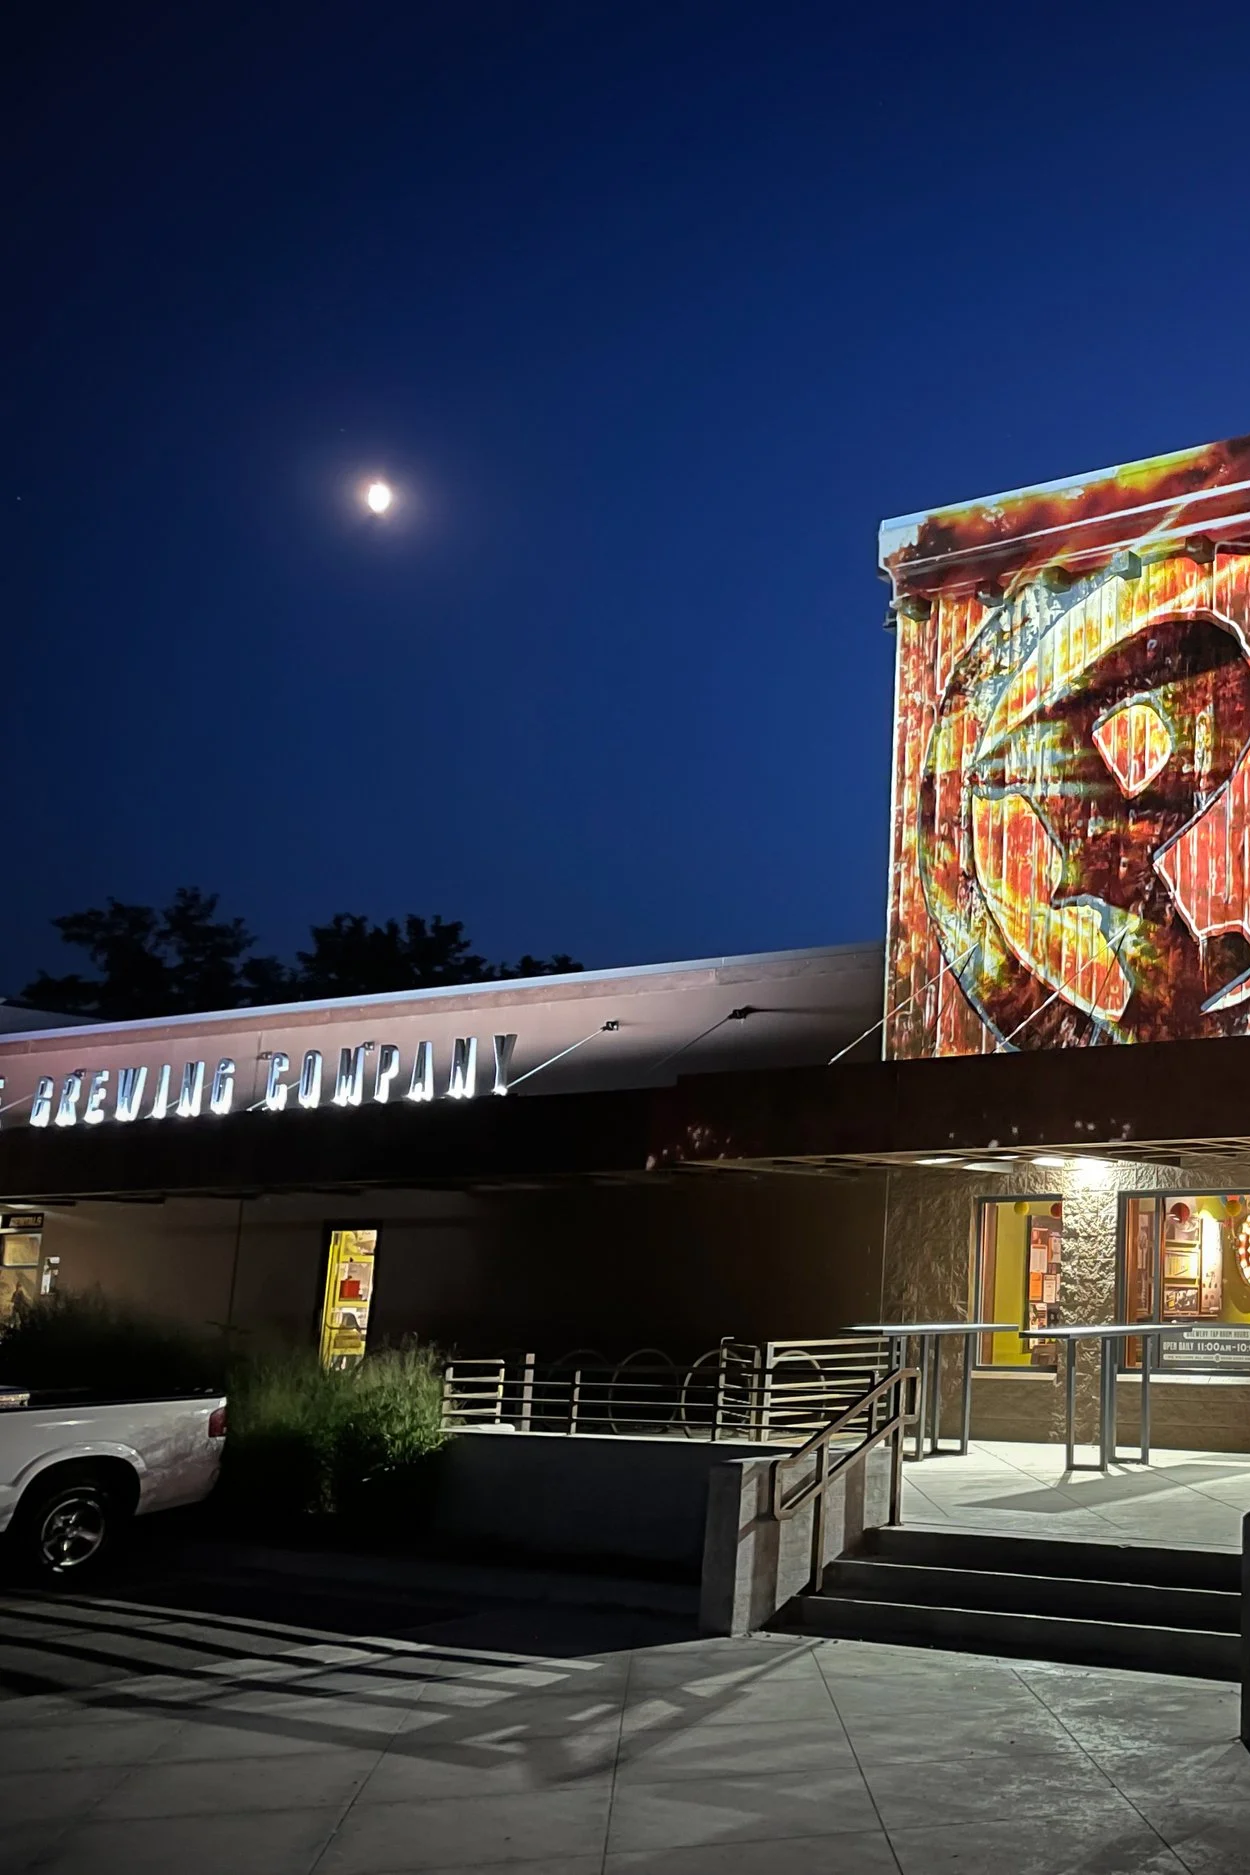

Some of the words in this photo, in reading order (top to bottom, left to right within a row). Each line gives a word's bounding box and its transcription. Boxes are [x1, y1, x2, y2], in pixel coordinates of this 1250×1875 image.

[30, 1058, 235, 1127] BREWING
[265, 1033, 518, 1110] COMPANY
[1163, 1341, 1177, 1351] OPEN
[1178, 1341, 1194, 1351] DAILY
